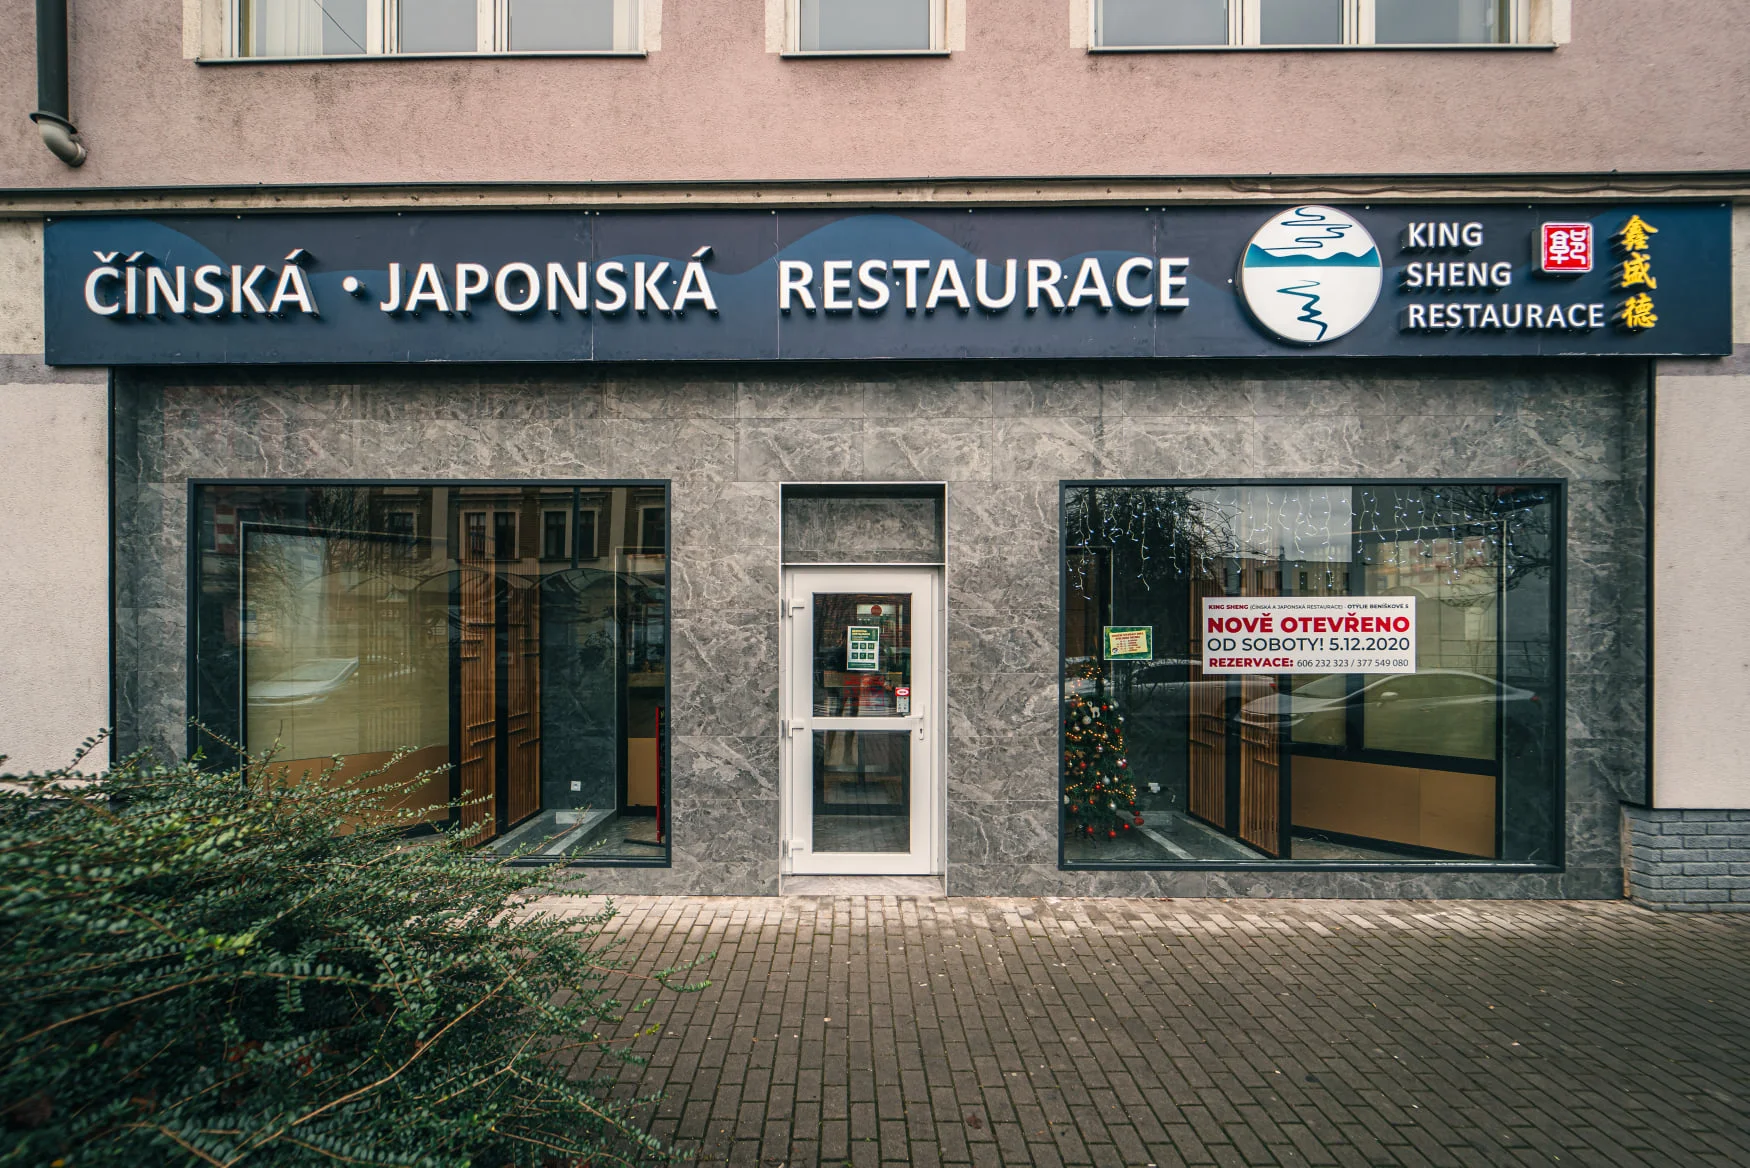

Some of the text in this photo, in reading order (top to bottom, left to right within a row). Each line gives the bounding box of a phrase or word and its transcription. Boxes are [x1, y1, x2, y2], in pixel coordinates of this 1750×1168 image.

[1407, 222, 1484, 248] KING
[84, 248, 314, 316] ČÍNSKÁ
[380, 246, 719, 313] JAPONSKÁ
[778, 257, 1191, 310] RESTAURACE
[1406, 261, 1513, 287] SHENG
[1619, 214, 1659, 329] 鑫盛德
[1408, 303, 1605, 328] RESTAURACE
[1207, 612, 1410, 634] NOVĚ OTEVŘENO
[1207, 637, 1410, 651] OD SOBOTY! 5.12.2020
[1209, 657, 1294, 668] REZERVACE:
[1297, 659, 1313, 668] 606
[1315, 659, 1331, 667] 232
[1333, 659, 1349, 667] 323
[1357, 659, 1373, 667] 377
[1374, 658, 1391, 667] 549
[1392, 658, 1409, 667] 080
